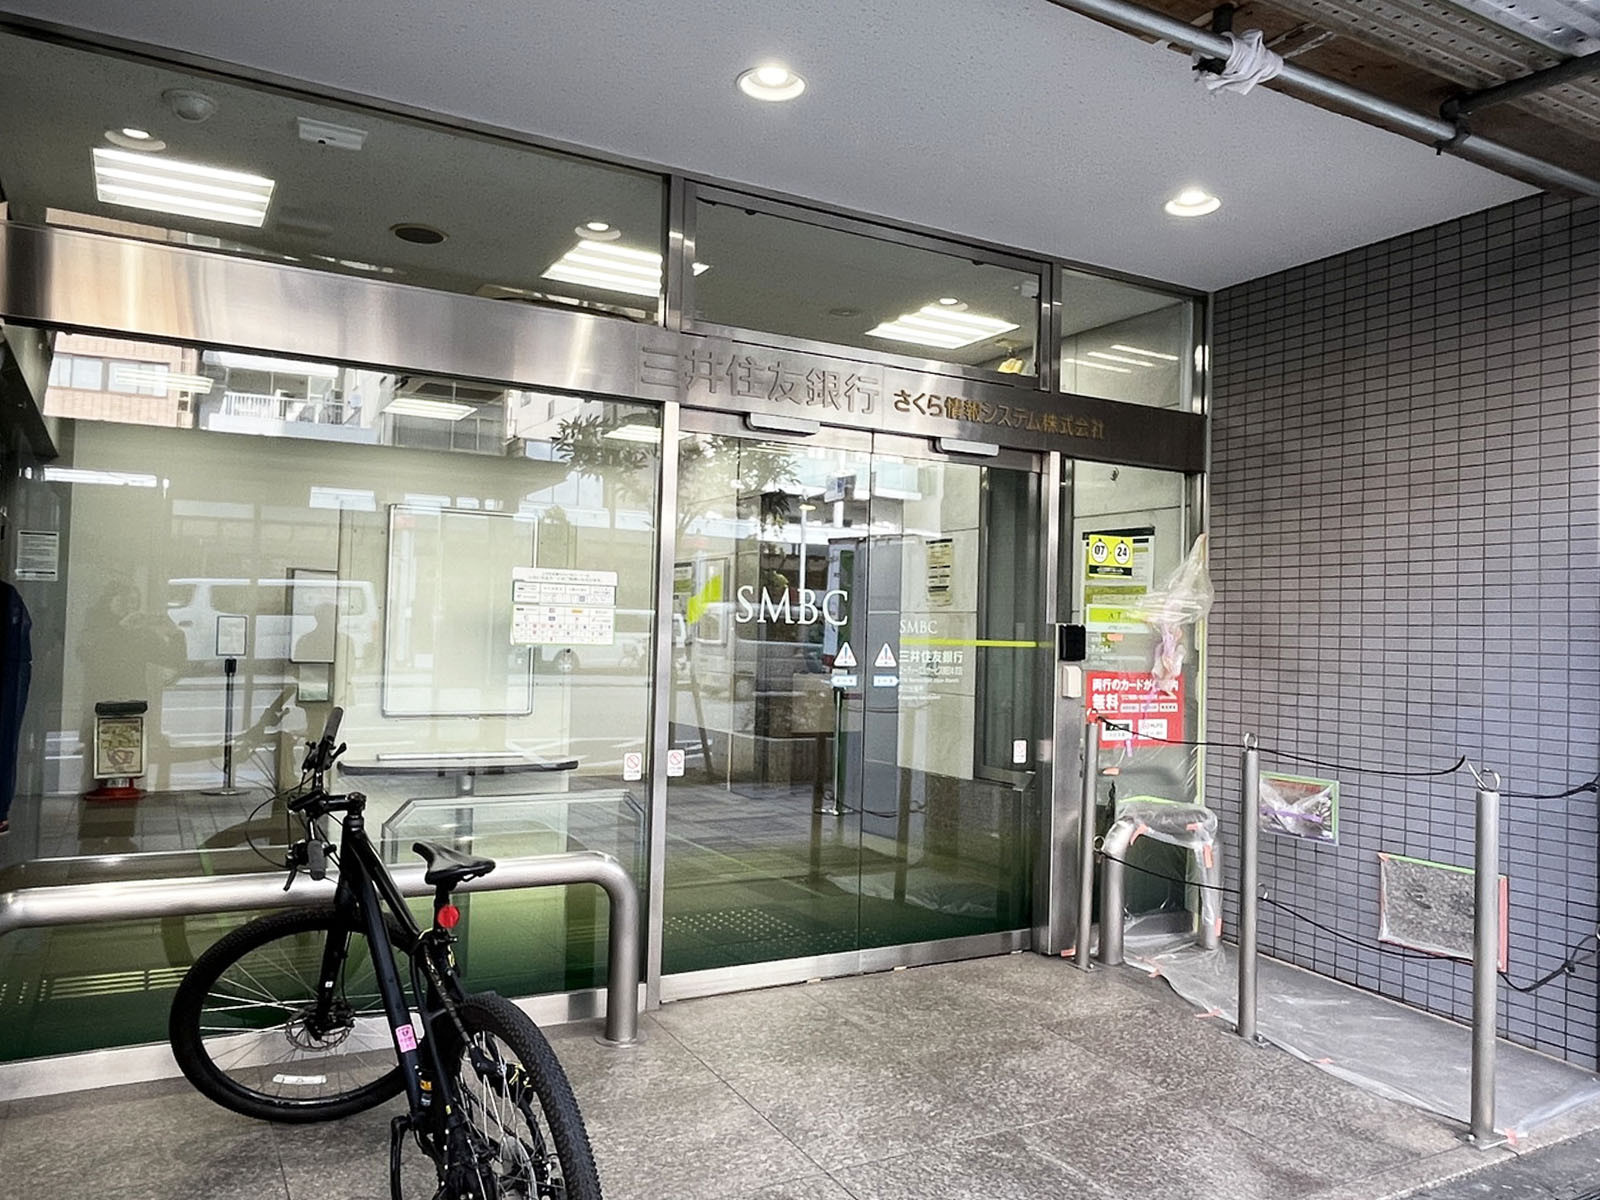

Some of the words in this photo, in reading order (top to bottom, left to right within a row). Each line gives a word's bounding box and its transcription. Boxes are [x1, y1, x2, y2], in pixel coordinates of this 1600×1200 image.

[640, 346, 879, 415] 三井住友銀行
[893, 389, 1105, 440] さくら情報システム株式会社
[1094, 544, 1105, 555] 07
[1117, 546, 1128, 557] 24
[735, 585, 848, 626] SMBC
[899, 619, 938, 634] SMBC
[899, 650, 963, 664] 三井住友銀行
